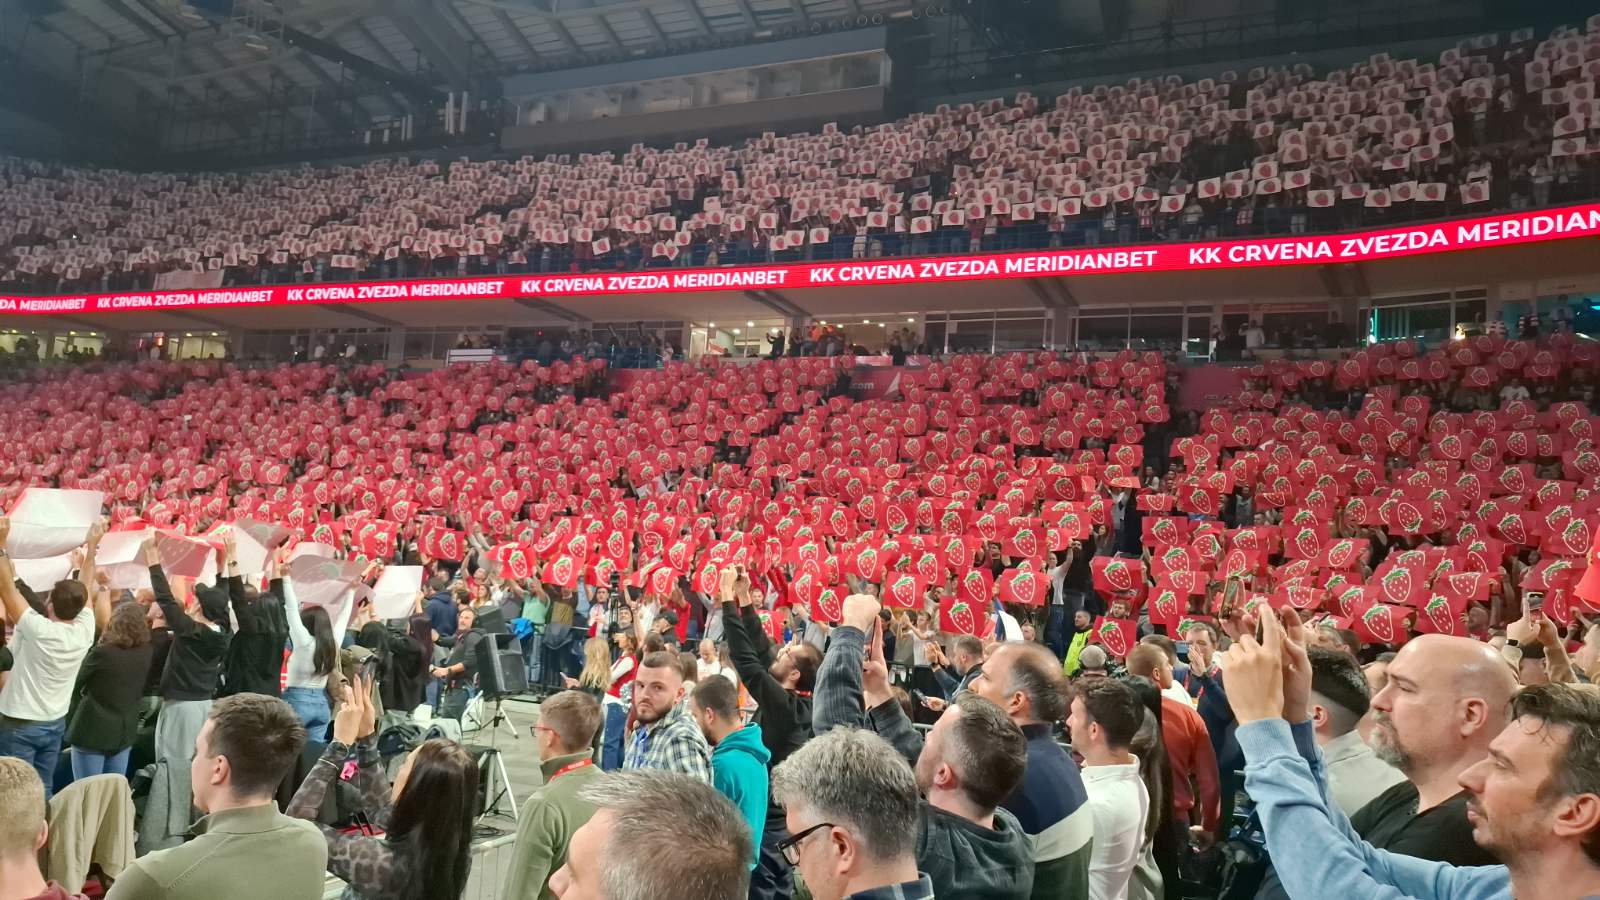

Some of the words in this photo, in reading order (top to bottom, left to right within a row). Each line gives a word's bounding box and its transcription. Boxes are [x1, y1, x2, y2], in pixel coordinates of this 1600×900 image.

[1189, 247, 1222, 264] KK
[1228, 242, 1334, 262] CRVENA
[1339, 229, 1449, 257] ZVEZDA
[809, 267, 836, 282] KK
[837, 264, 916, 281] CRVENA
[919, 260, 1000, 277] ZVEZDA
[1004, 251, 1158, 273] MERIDIANBET
[520, 280, 542, 292] KK
[543, 278, 605, 292] CRVENA
[607, 275, 670, 290] ZVEZDA
[674, 269, 789, 287] MERIDIANBET
[97, 297, 111, 308] KK
[112, 296, 153, 307] CRVENA
[153, 294, 197, 305] ZVEZDA
[197, 290, 274, 303] MERIDIANBET
[286, 289, 304, 300] KK
[305, 288, 356, 300] CRVENA
[357, 286, 409, 298] ZVEZDA
[410, 282, 505, 296] MERIDIANBET
[19, 299, 87, 310] MERIDIANBET
